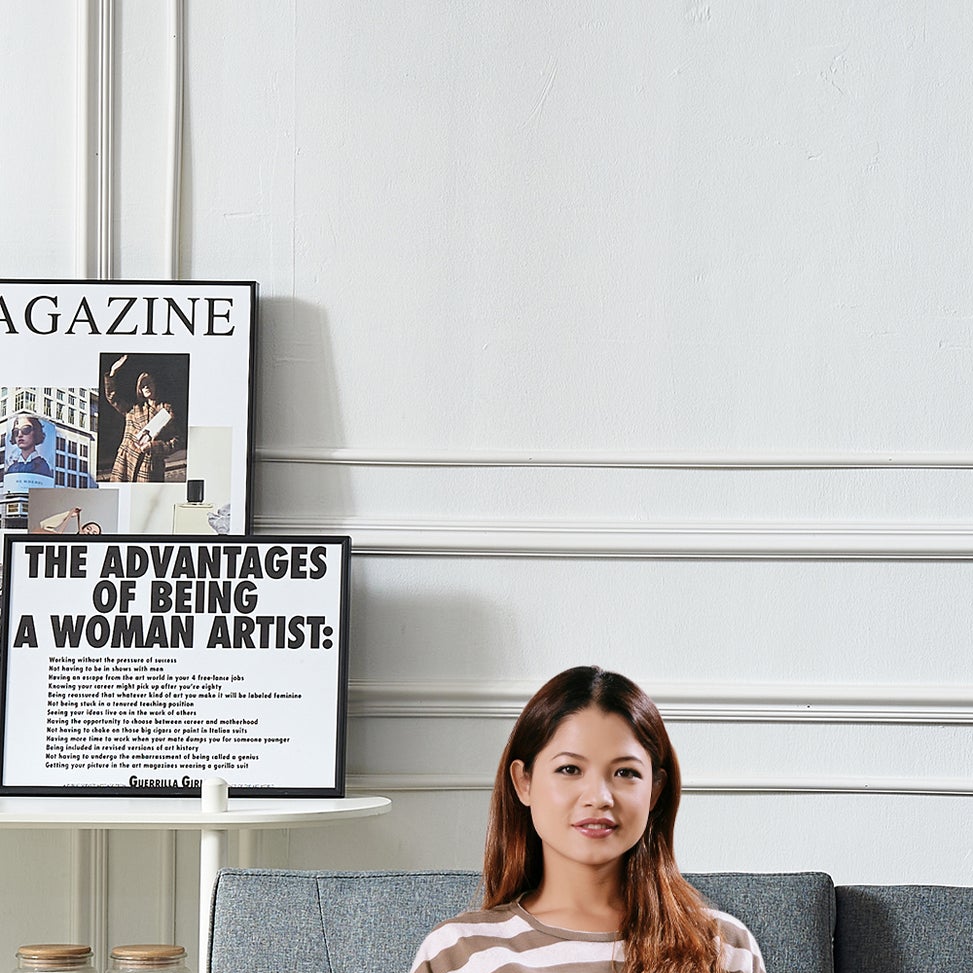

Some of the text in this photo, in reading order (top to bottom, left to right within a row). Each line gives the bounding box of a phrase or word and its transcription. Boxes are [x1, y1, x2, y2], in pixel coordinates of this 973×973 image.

[25, 545, 328, 580] THE ADVANTAGES
[92, 580, 259, 615] OF BEING
[13, 614, 334, 650] A WOMAN ARTIST:
[49, 656, 76, 664] Working
[62, 665, 84, 673] having
[48, 674, 70, 682] Having
[231, 674, 244, 683] jobs
[48, 682, 76, 691] Knowing
[116, 683, 135, 691] might
[136, 683, 149, 691] pick
[201, 683, 222, 691] eighty
[48, 691, 66, 700] Being
[60, 700, 78, 708] being
[139, 700, 167, 709] teaching
[168, 700, 194, 709] position
[47, 709, 68, 717] Seeing
[47, 718, 69, 726] Having
[83, 718, 121, 726] opportunity
[59, 726, 81, 735] having
[141, 727, 151, 735] big
[153, 727, 172, 735] cigars
[182, 727, 199, 735] paint
[46, 735, 68, 744] Having
[186, 736, 207, 744] dumps
[46, 744, 64, 752] Being
[176, 744, 199, 753] history
[58, 753, 80, 761] having
[91, 753, 117, 761] undergo
[192, 753, 210, 762] being
[238, 753, 259, 762] genius
[45, 762, 69, 770] Getting
[87, 762, 109, 770] picture
[143, 762, 178, 770] magazines
[179, 762, 206, 770] wearing
[213, 762, 235, 770] gorilla
[181, 775, 203, 787] GIRL
